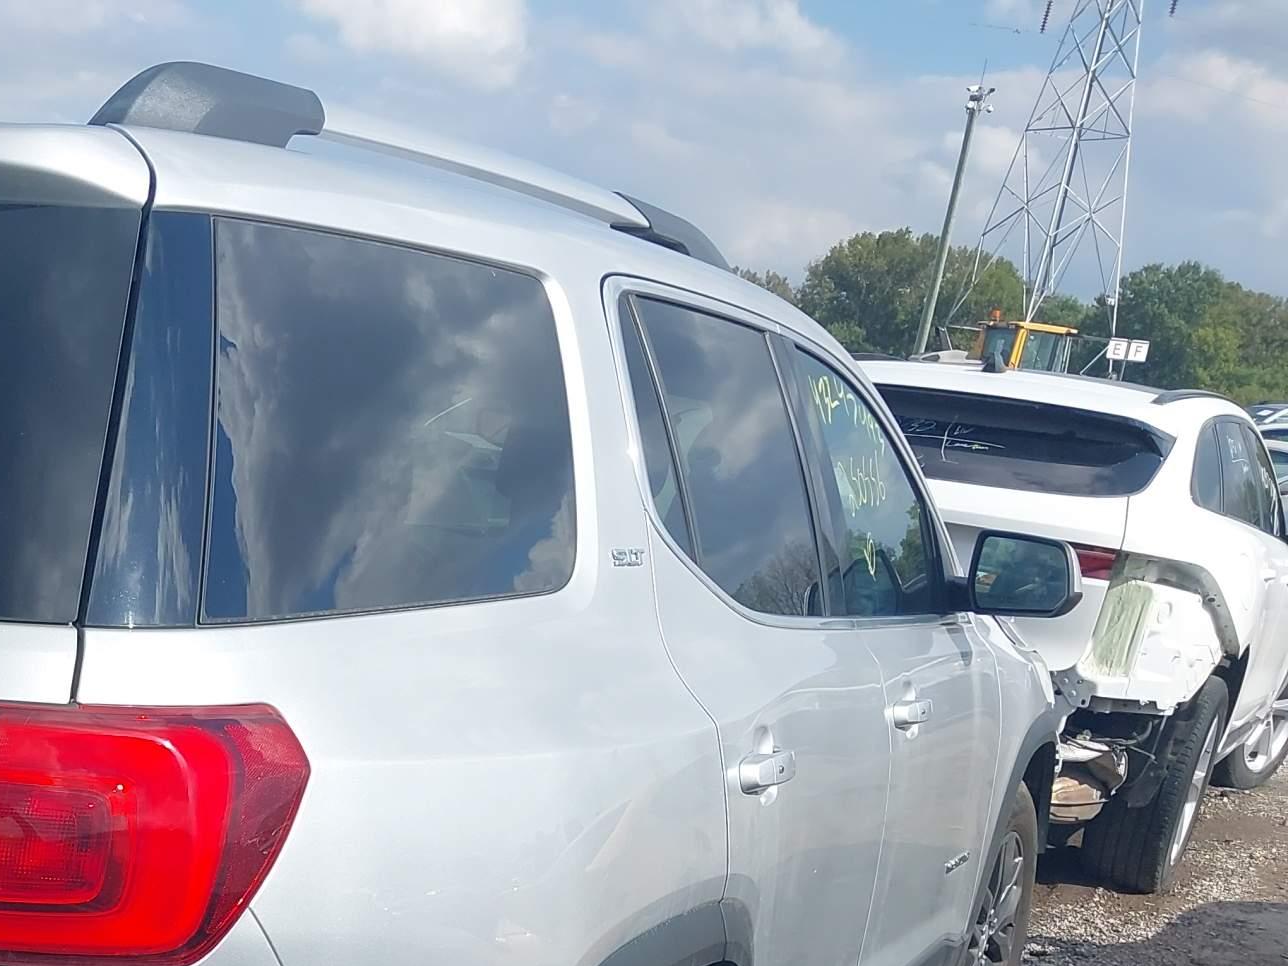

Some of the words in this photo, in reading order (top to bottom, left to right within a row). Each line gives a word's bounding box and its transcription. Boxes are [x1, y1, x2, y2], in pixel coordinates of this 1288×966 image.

[1113, 343, 1122, 356] E
[1134, 345, 1143, 358] F
[611, 548, 644, 567] SLT
